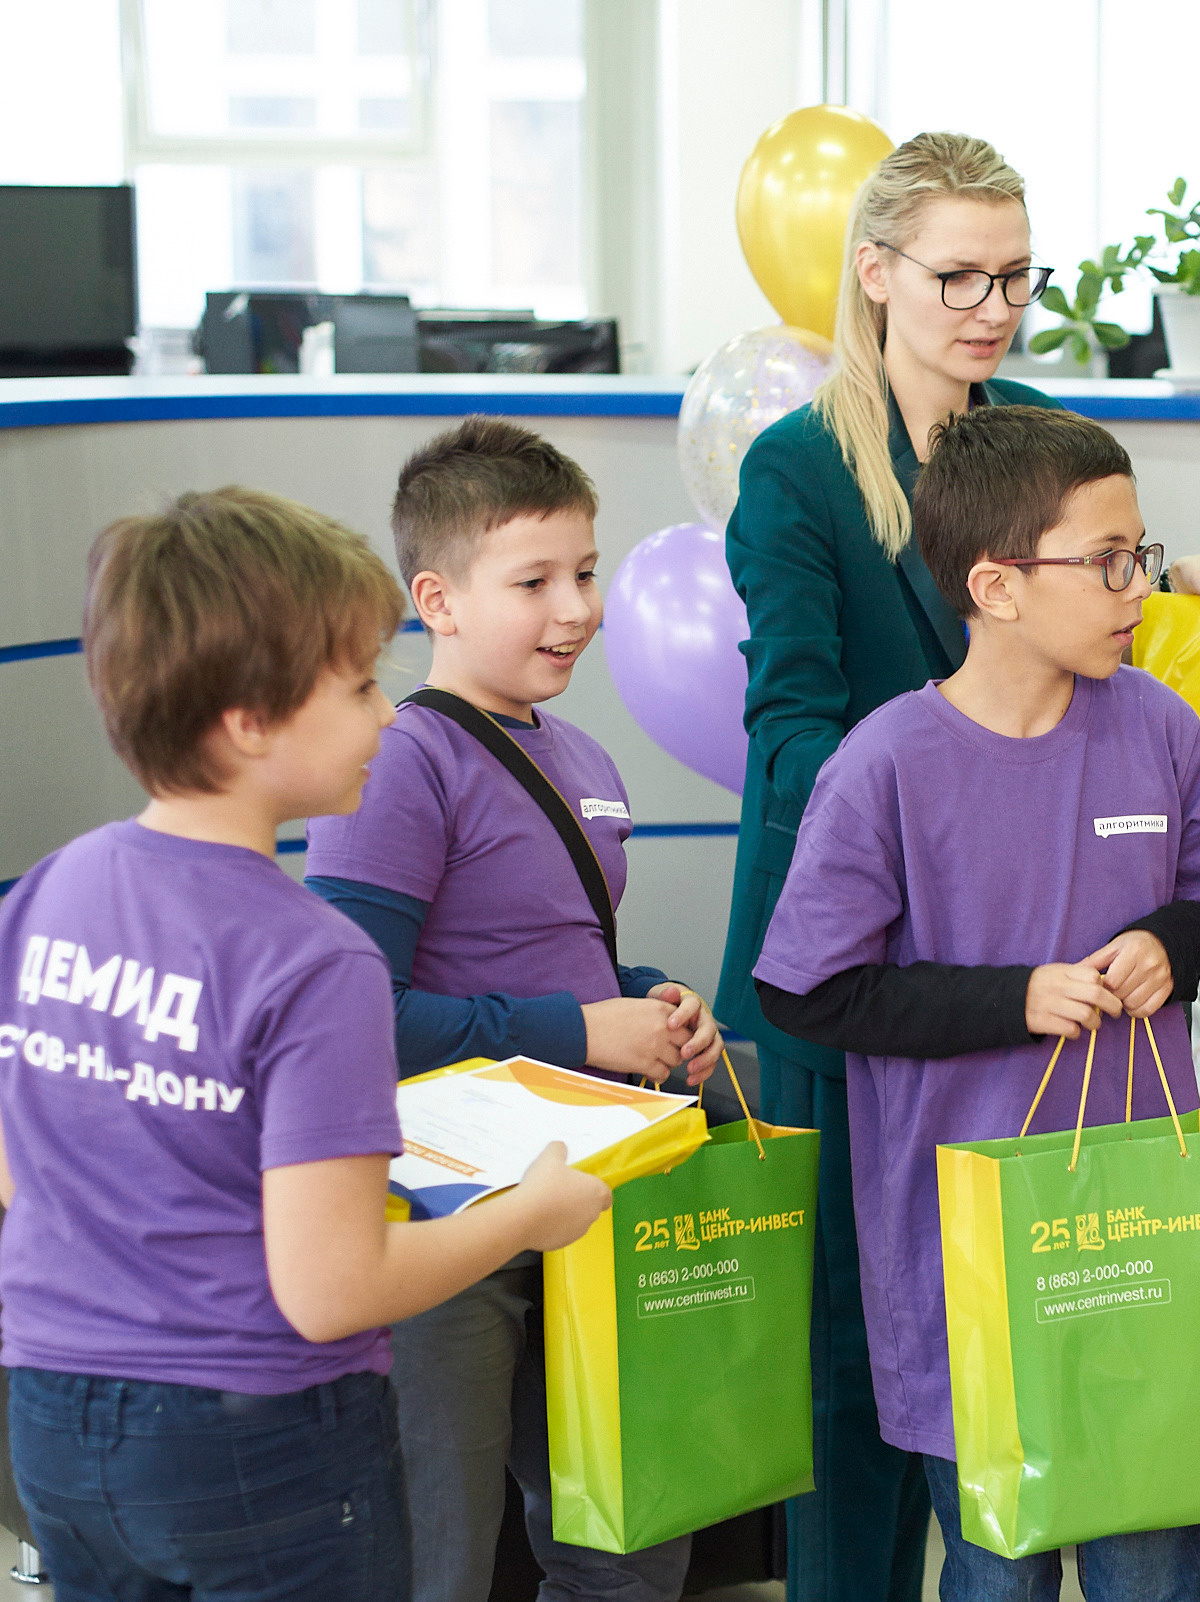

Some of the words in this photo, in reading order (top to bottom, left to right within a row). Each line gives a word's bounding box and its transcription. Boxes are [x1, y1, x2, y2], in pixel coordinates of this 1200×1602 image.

[1099, 820, 1164, 830] алгоритмика
[18, 935, 203, 1052] ДЕМИД
[0, 1023, 246, 1113] СОВ-Н-ДОНУ
[699, 1207, 730, 1224] БАНК
[700, 1210, 805, 1243] ЦЕНТР-ИНВЕСТ
[1106, 1206, 1146, 1223] БАНК
[634, 1218, 670, 1252] 25
[654, 1239, 670, 1250] лет
[1030, 1218, 1071, 1253] 25
[1053, 1239, 1070, 1250] лет
[638, 1273, 646, 1288] 8
[649, 1268, 679, 1288] (863)
[681, 1258, 739, 1282] 2-000-000
[1036, 1276, 1046, 1291] 8
[1049, 1272, 1080, 1292] (863)
[1083, 1259, 1154, 1283] 2-000-000
[644, 1283, 747, 1312] www.centrinvest.ru
[1044, 1285, 1163, 1317] www.centrinvest.ru
